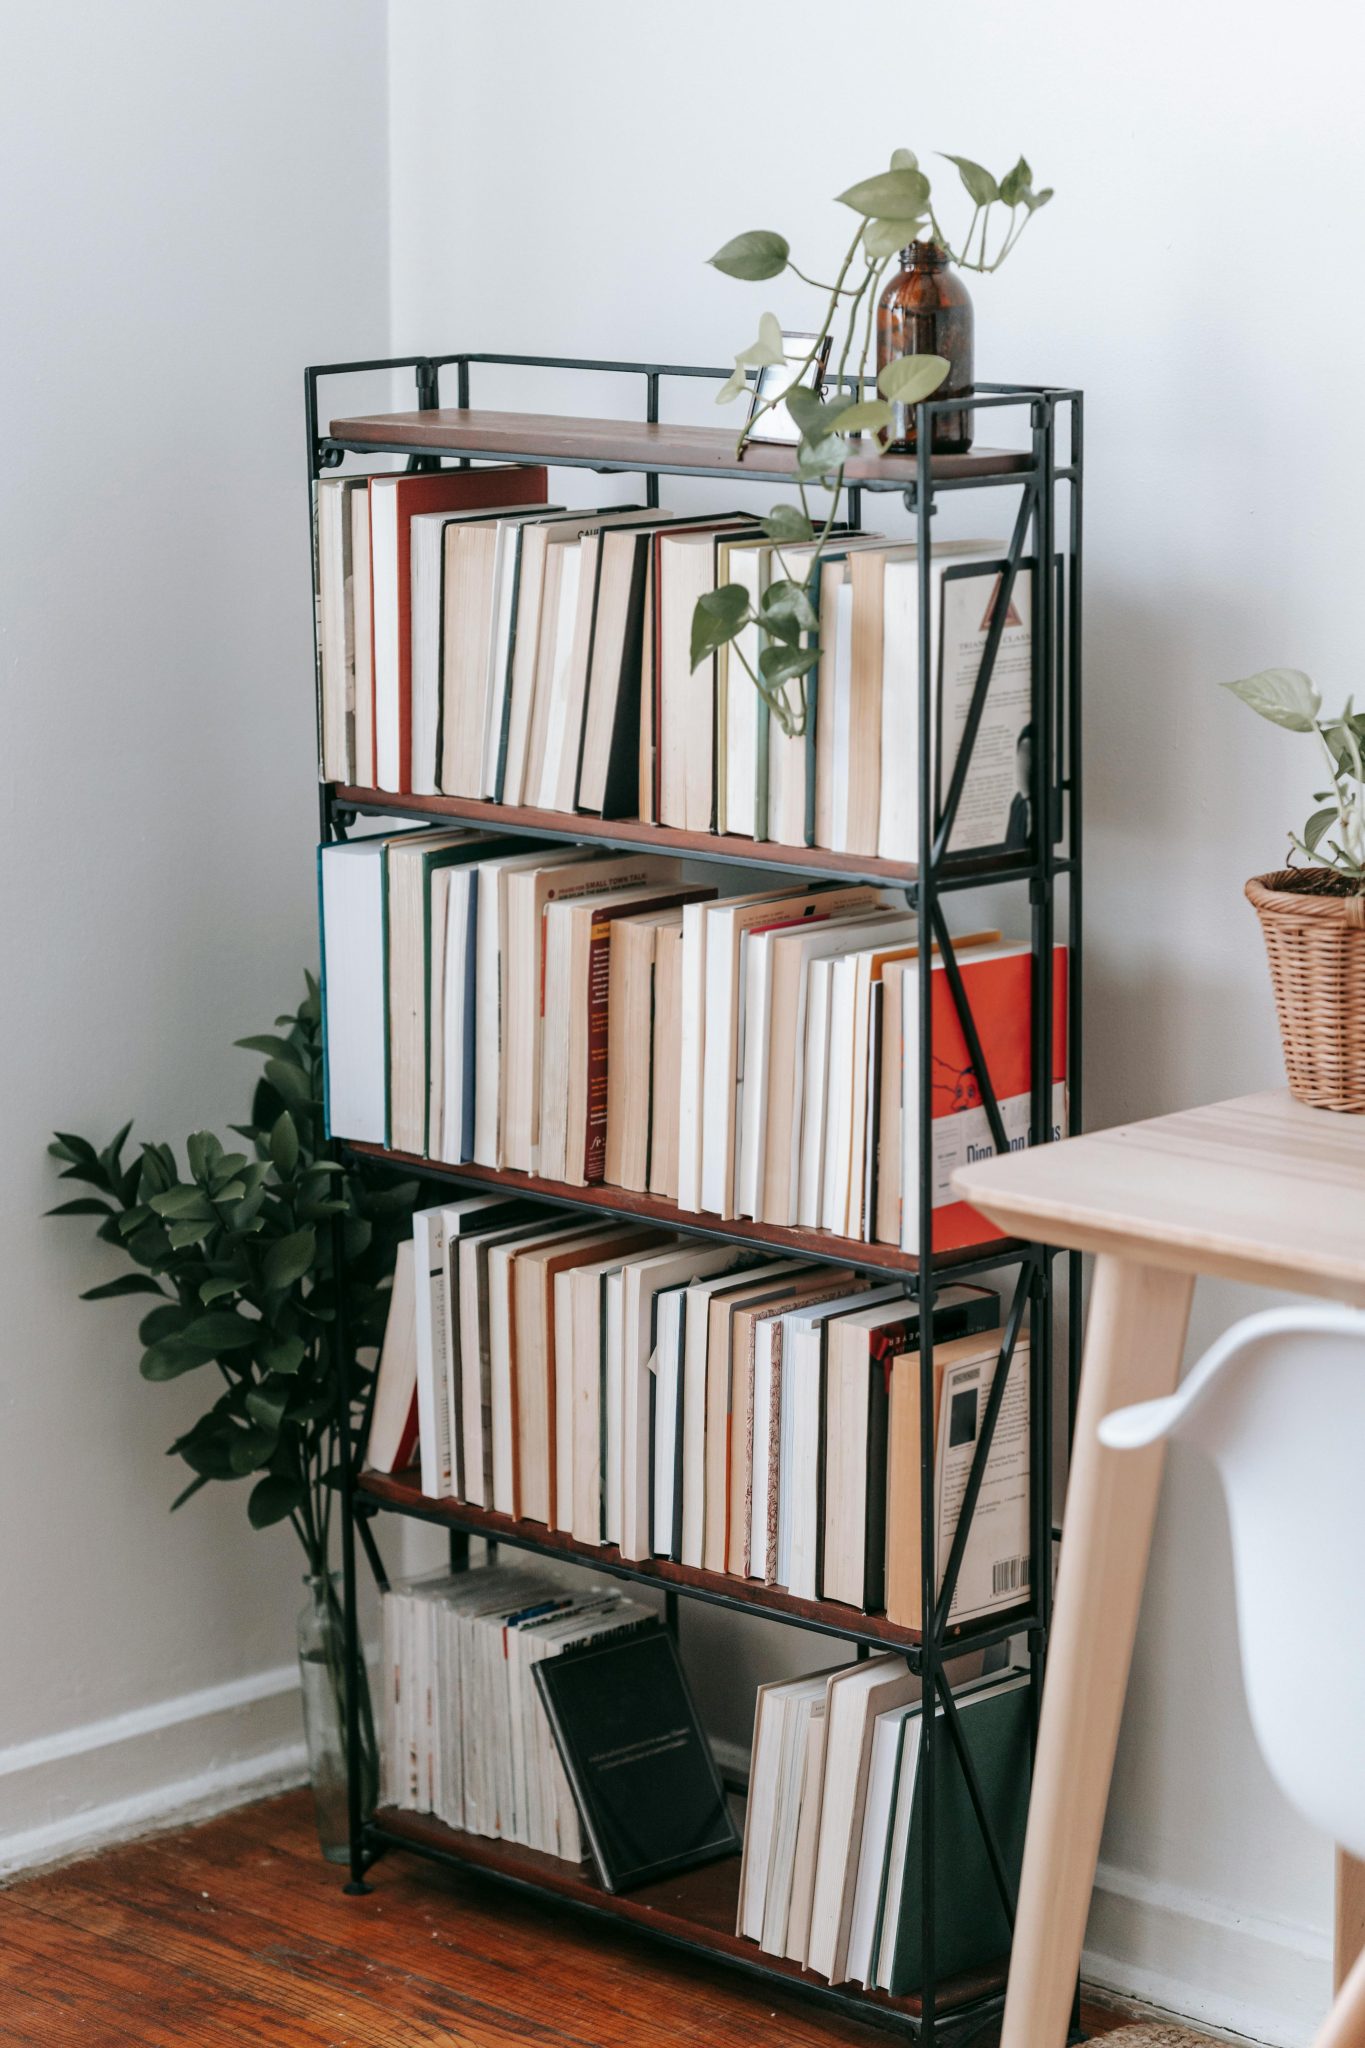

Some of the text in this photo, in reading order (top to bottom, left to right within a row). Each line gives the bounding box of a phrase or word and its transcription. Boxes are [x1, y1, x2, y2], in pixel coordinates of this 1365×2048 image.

[959, 639, 986, 650] TRIAN
[585, 879, 608, 889] SMALL
[609, 876, 628, 885] TOWN
